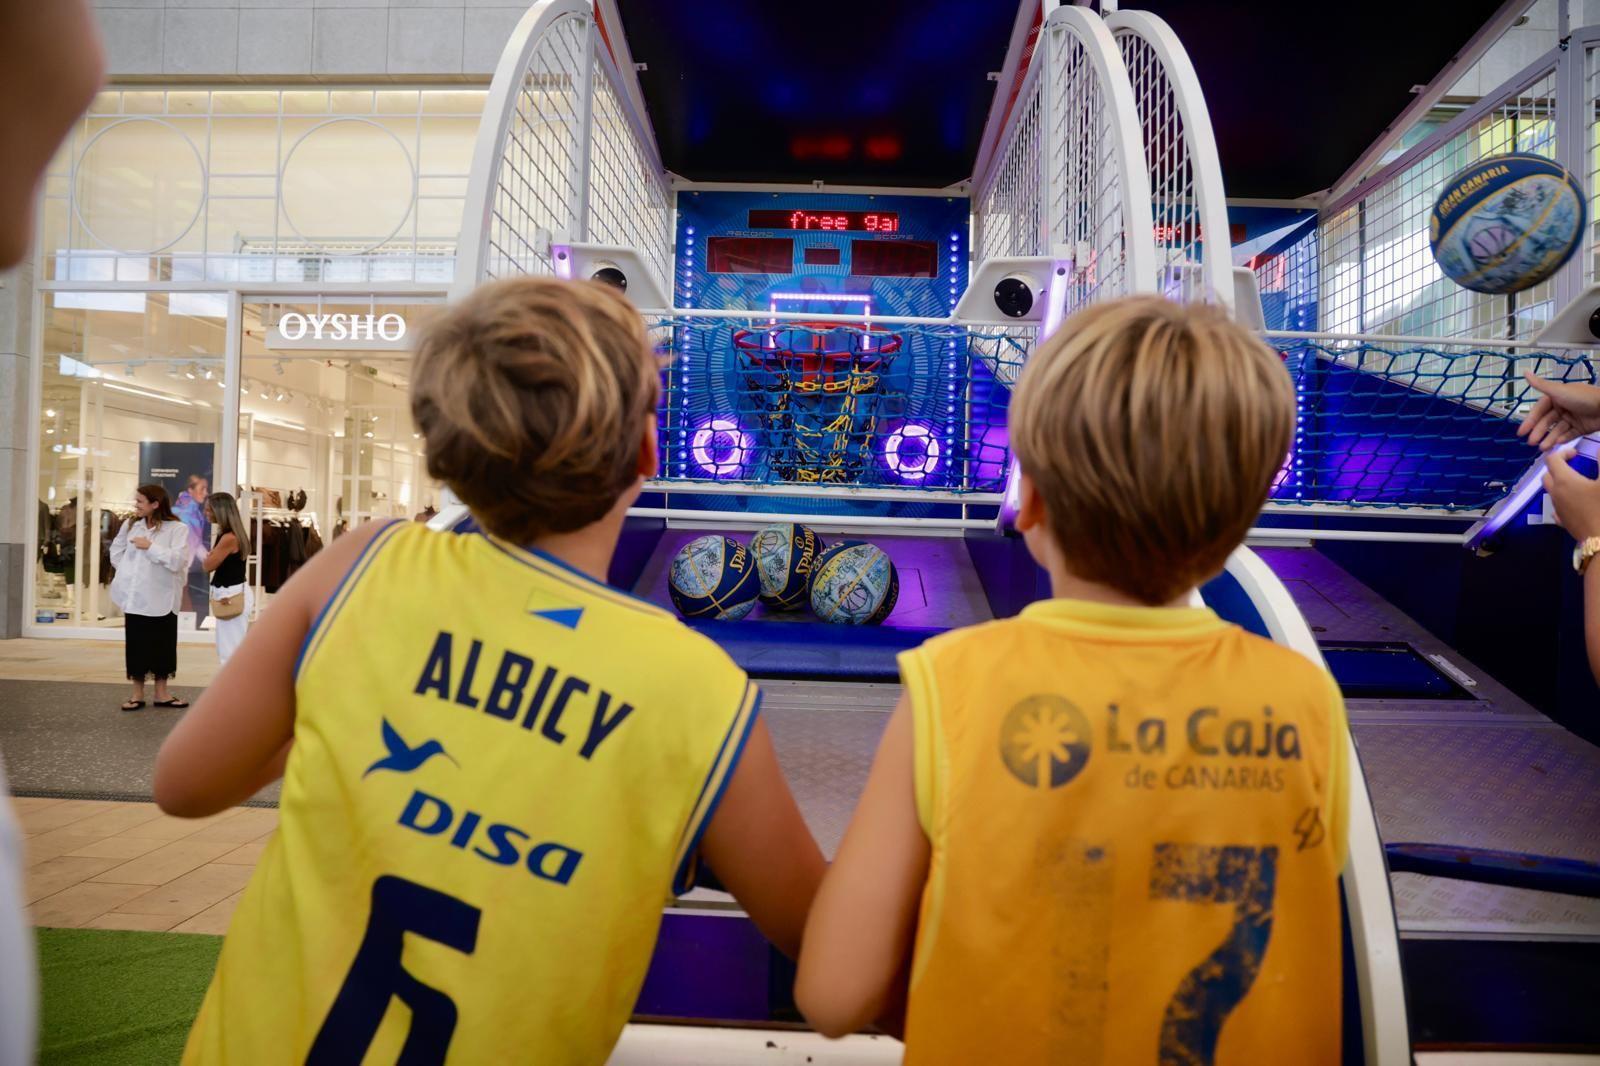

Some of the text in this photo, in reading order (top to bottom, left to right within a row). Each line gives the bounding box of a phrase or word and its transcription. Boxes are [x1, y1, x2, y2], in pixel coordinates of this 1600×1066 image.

[1461, 165, 1510, 194] CANARIA
[726, 230, 774, 238] RECORD
[790, 211, 899, 232] free ga
[279, 312, 406, 341] OYSHO
[414, 631, 635, 761] ALBICY
[1107, 703, 1303, 761] La Caja
[1124, 765, 1285, 793] de CANARIAS
